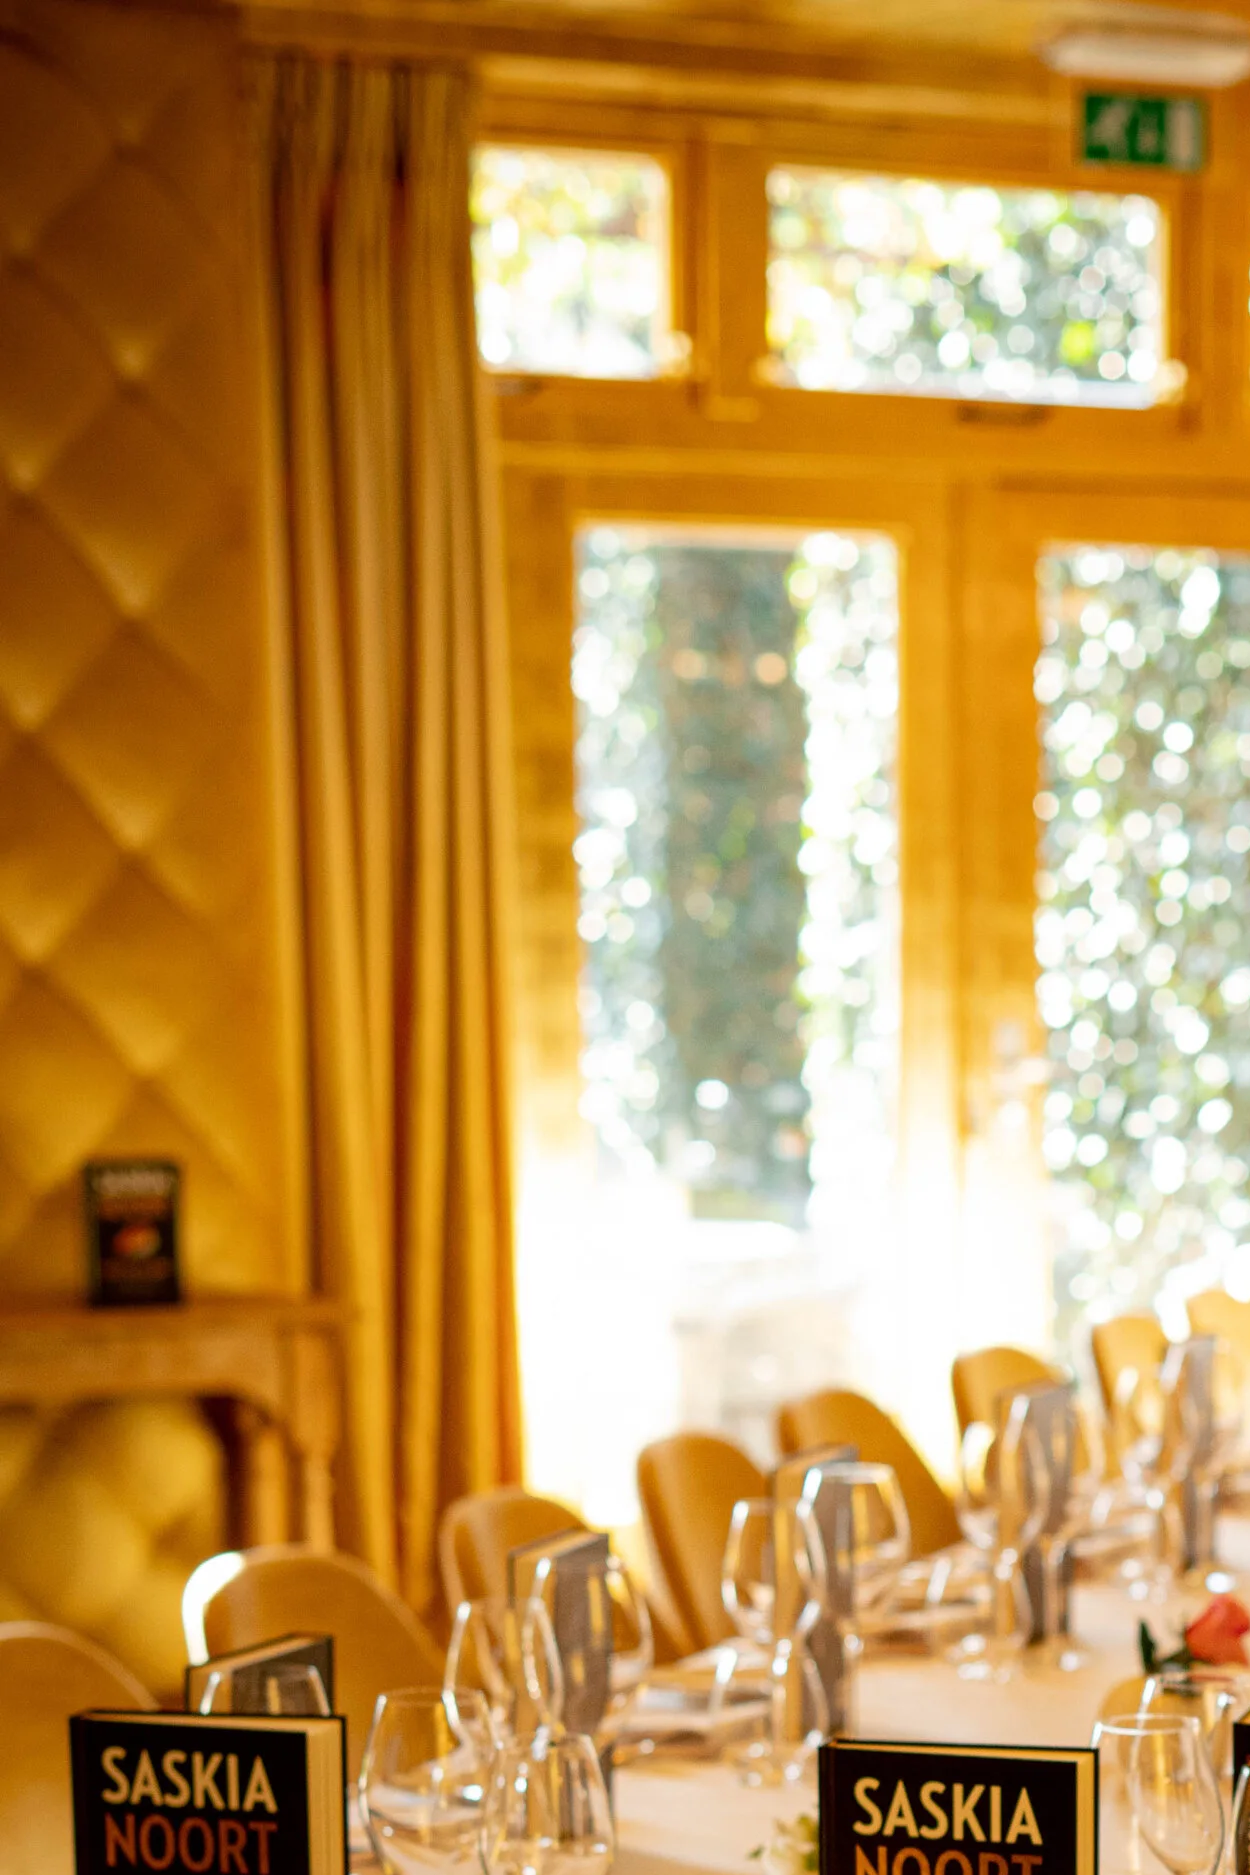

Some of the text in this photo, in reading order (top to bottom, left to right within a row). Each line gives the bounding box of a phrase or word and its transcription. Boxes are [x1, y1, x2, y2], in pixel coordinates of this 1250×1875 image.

[101, 1746, 278, 1814] SASKIA
[853, 1776, 1043, 1845] SASKIA
[105, 1812, 278, 1875] NOORT
